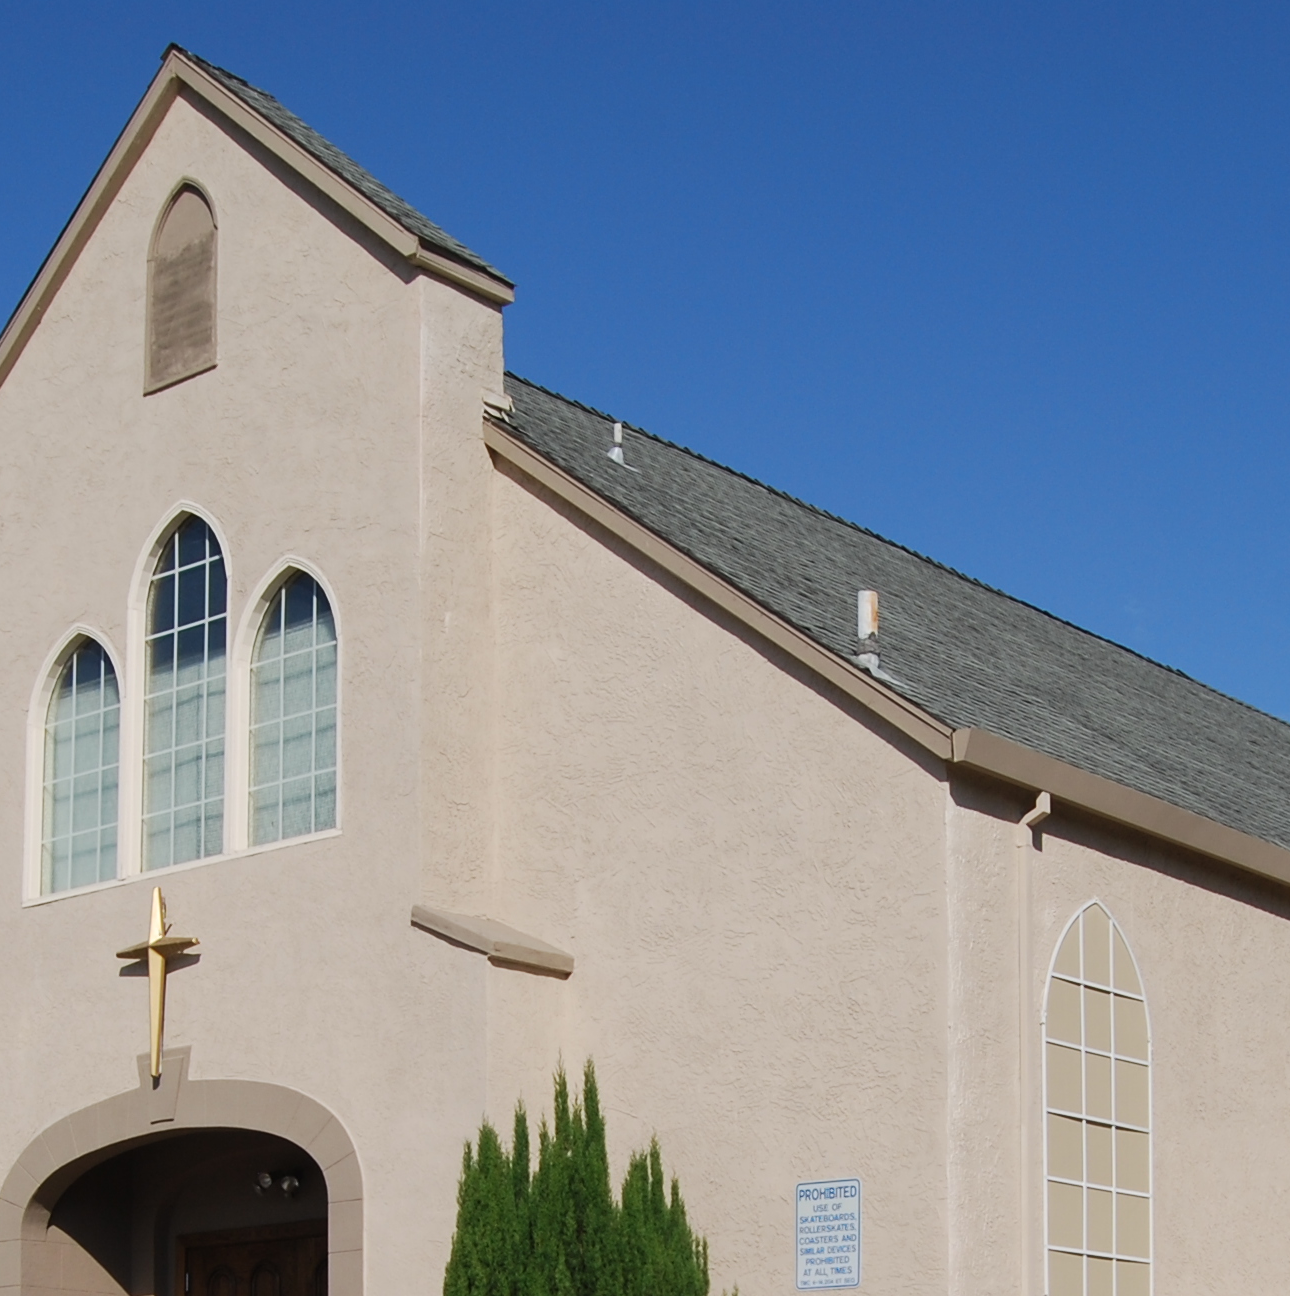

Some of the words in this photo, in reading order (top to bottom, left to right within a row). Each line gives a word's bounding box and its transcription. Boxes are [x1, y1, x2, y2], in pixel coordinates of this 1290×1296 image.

[799, 1185, 857, 1201] PROHIBITED
[813, 1204, 828, 1212] USE
[832, 1203, 842, 1211] OF
[799, 1235, 839, 1245] COASTERS
[841, 1234, 857, 1242] AND
[800, 1246, 825, 1256] SIMILAR
[827, 1244, 856, 1254] DEVICES
[805, 1256, 850, 1266] PROHIBITED
[803, 1268, 812, 1277] AT
[830, 1266, 852, 1275] TIMES
